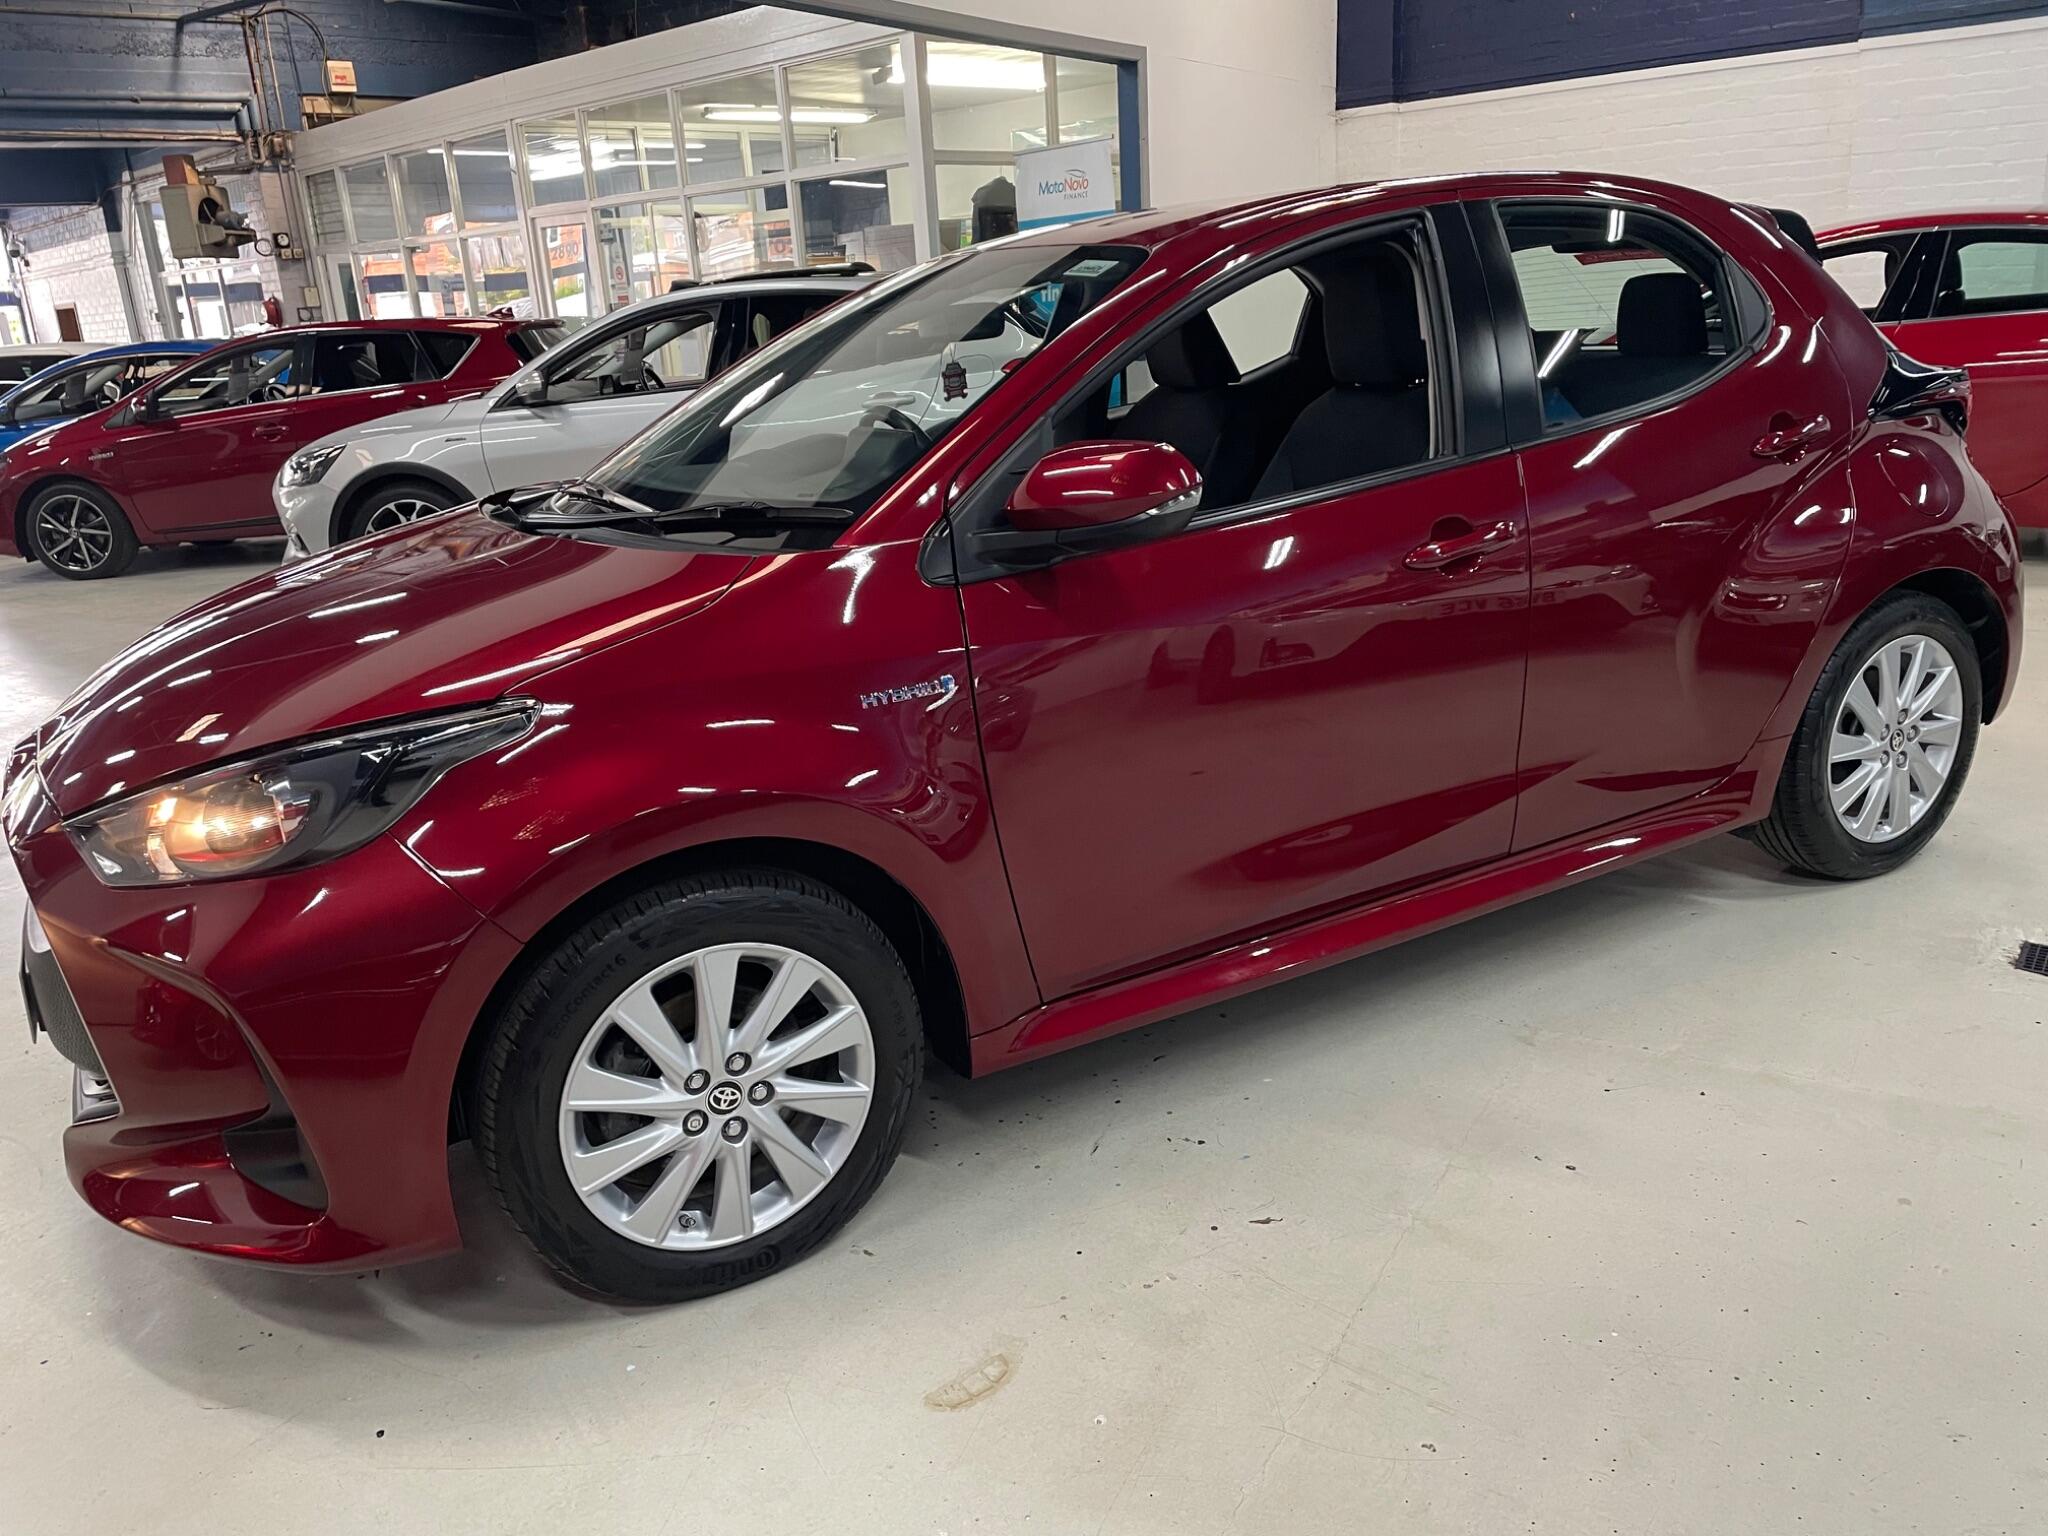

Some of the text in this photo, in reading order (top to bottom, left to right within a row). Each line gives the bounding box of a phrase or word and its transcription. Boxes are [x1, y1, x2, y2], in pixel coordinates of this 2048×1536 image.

[1038, 176, 1089, 196] MotoNovo
[1063, 191, 1088, 200] FINANCE
[860, 679, 942, 709] HYBRID
